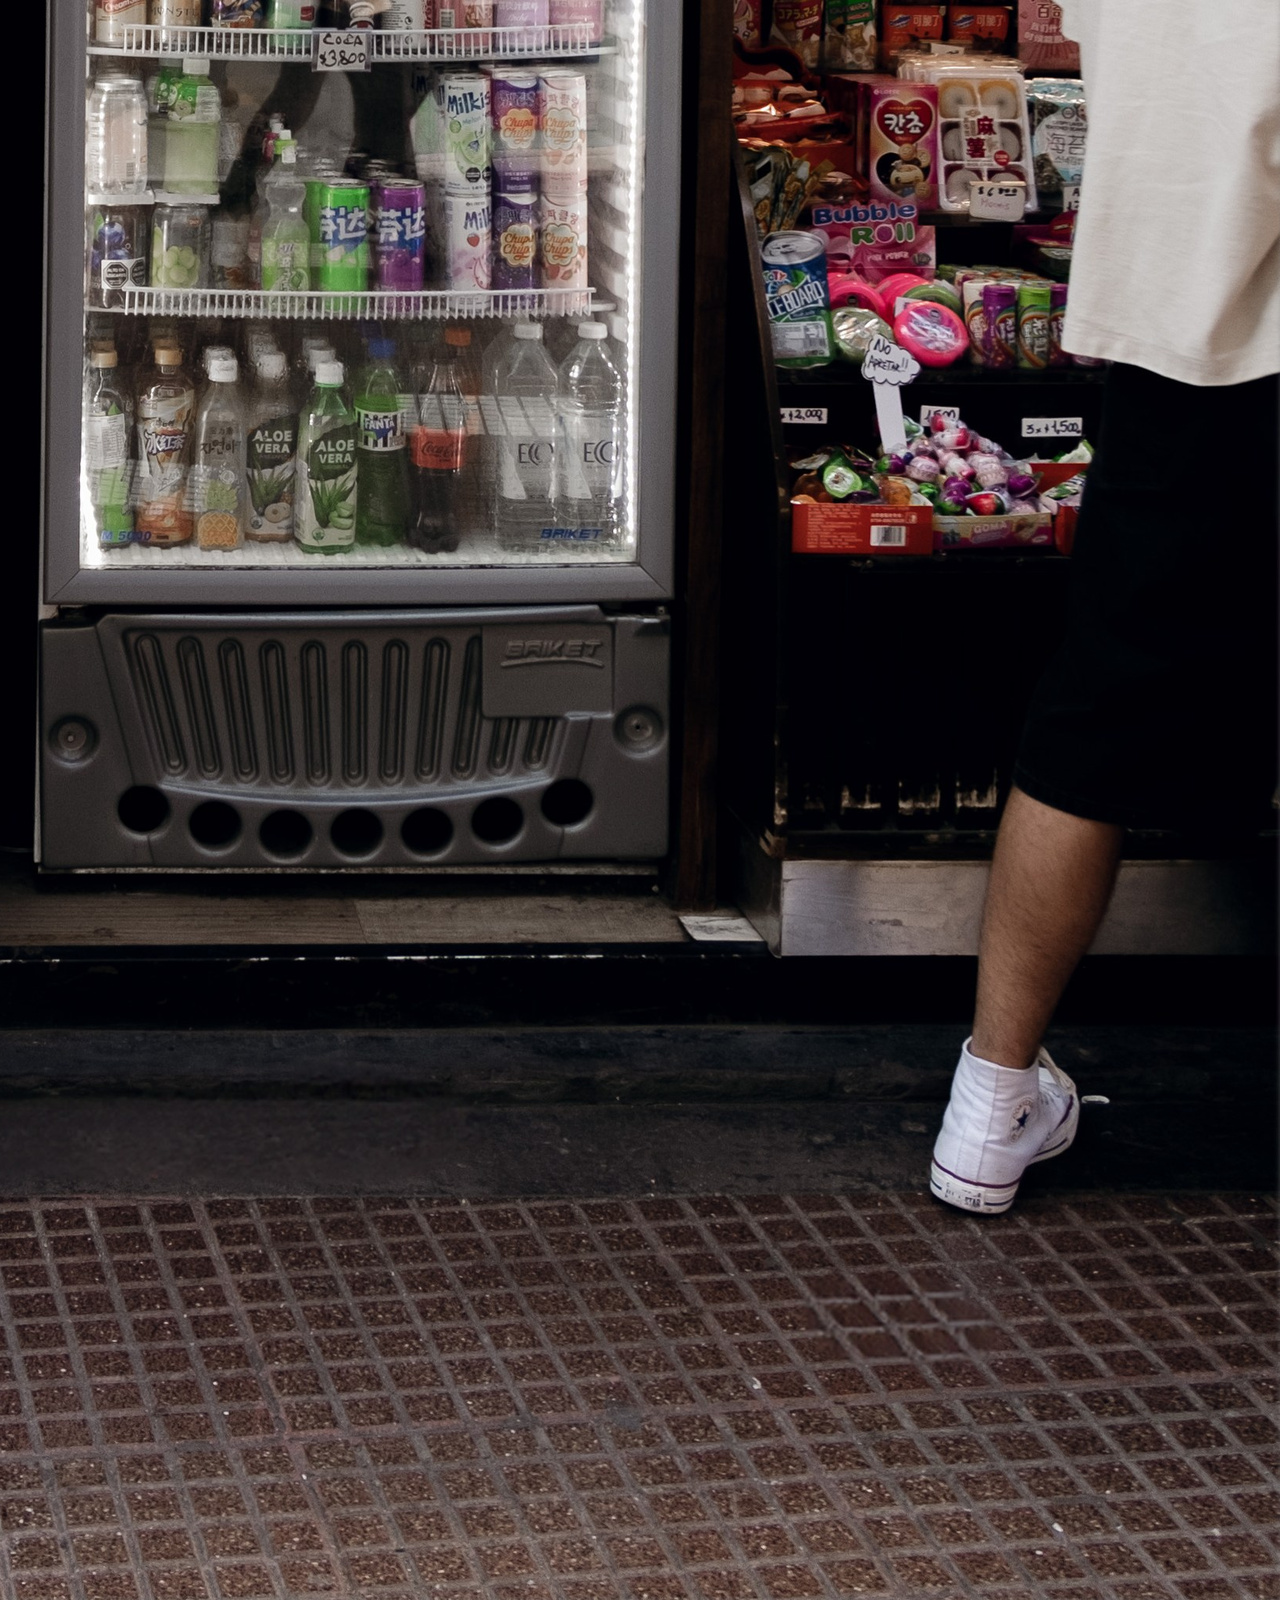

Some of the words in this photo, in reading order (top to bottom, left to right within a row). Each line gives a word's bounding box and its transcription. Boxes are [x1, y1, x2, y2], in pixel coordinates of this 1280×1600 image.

[323, 32, 363, 46] COCA
[447, 90, 491, 115] Milkis
[505, 117, 533, 128] Chupa
[545, 117, 575, 128] Chupa
[884, 112, 925, 135] 칸초
[813, 202, 916, 226] Bubble
[377, 207, 425, 244] 芬达
[505, 233, 534, 244] Chupa
[545, 233, 574, 244] Chupa
[851, 221, 916, 247] Roll
[544, 243, 573, 260] Chups
[364, 416, 395, 430] FANTA
[252, 429, 293, 442] ALOE
[255, 443, 290, 454] VERA
[315, 439, 355, 453] ALOE
[319, 453, 353, 465] VERA
[540, 528, 604, 540] BRIKET
[506, 638, 603, 660] BRIKET
